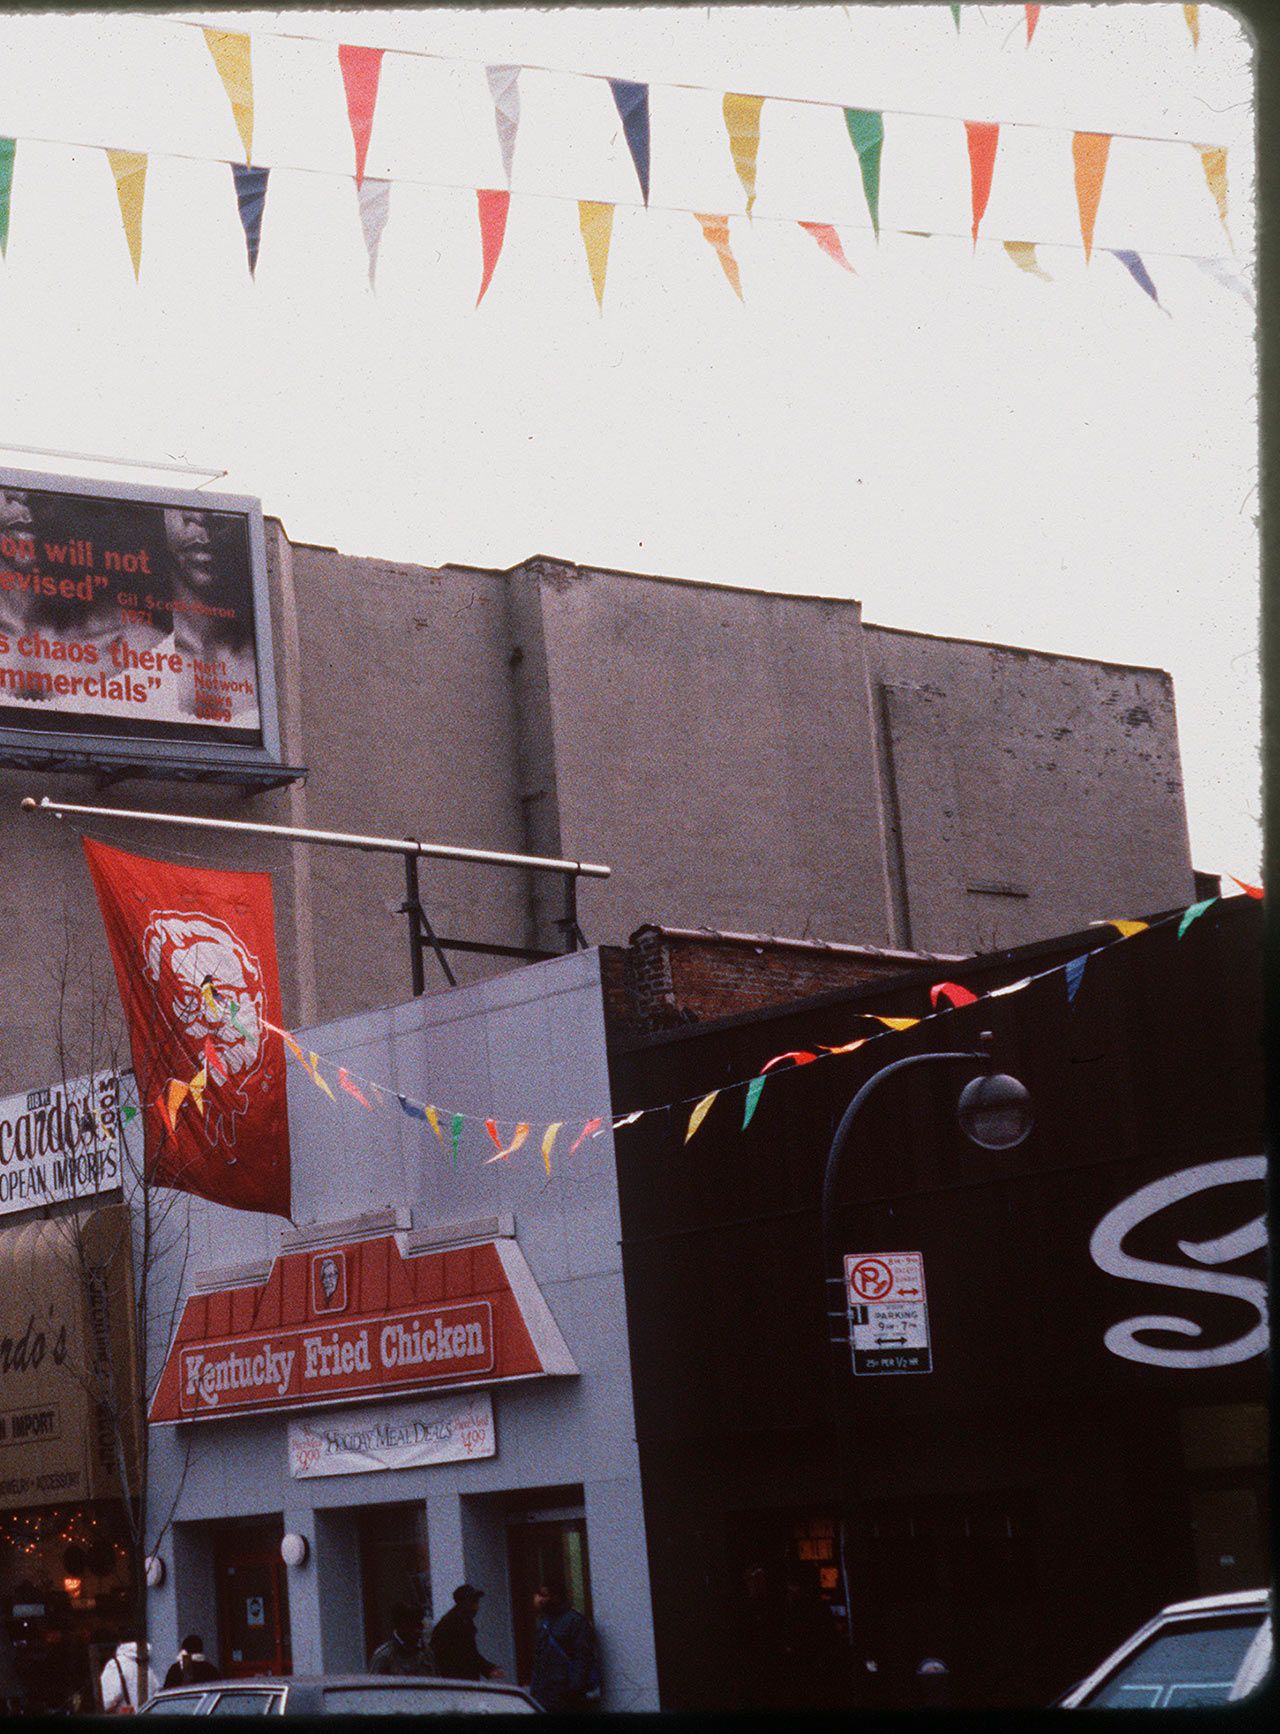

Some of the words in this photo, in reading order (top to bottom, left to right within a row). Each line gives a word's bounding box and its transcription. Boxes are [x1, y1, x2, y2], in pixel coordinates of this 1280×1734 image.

[44, 539, 94, 568] will
[104, 550, 152, 575] not
[16, 629, 100, 665] chaos
[110, 640, 184, 674] there
[52, 1145, 117, 1191] IMPORTS
[874, 1310, 919, 1320] PARKING
[185, 1344, 295, 1406] Kentucky
[303, 1330, 371, 1379] Fried
[380, 1318, 485, 1368] Chicken
[11, 1411, 55, 1439] IMPORT
[376, 1423, 413, 1448] MEAL
[413, 1420, 453, 1445] DEALS
